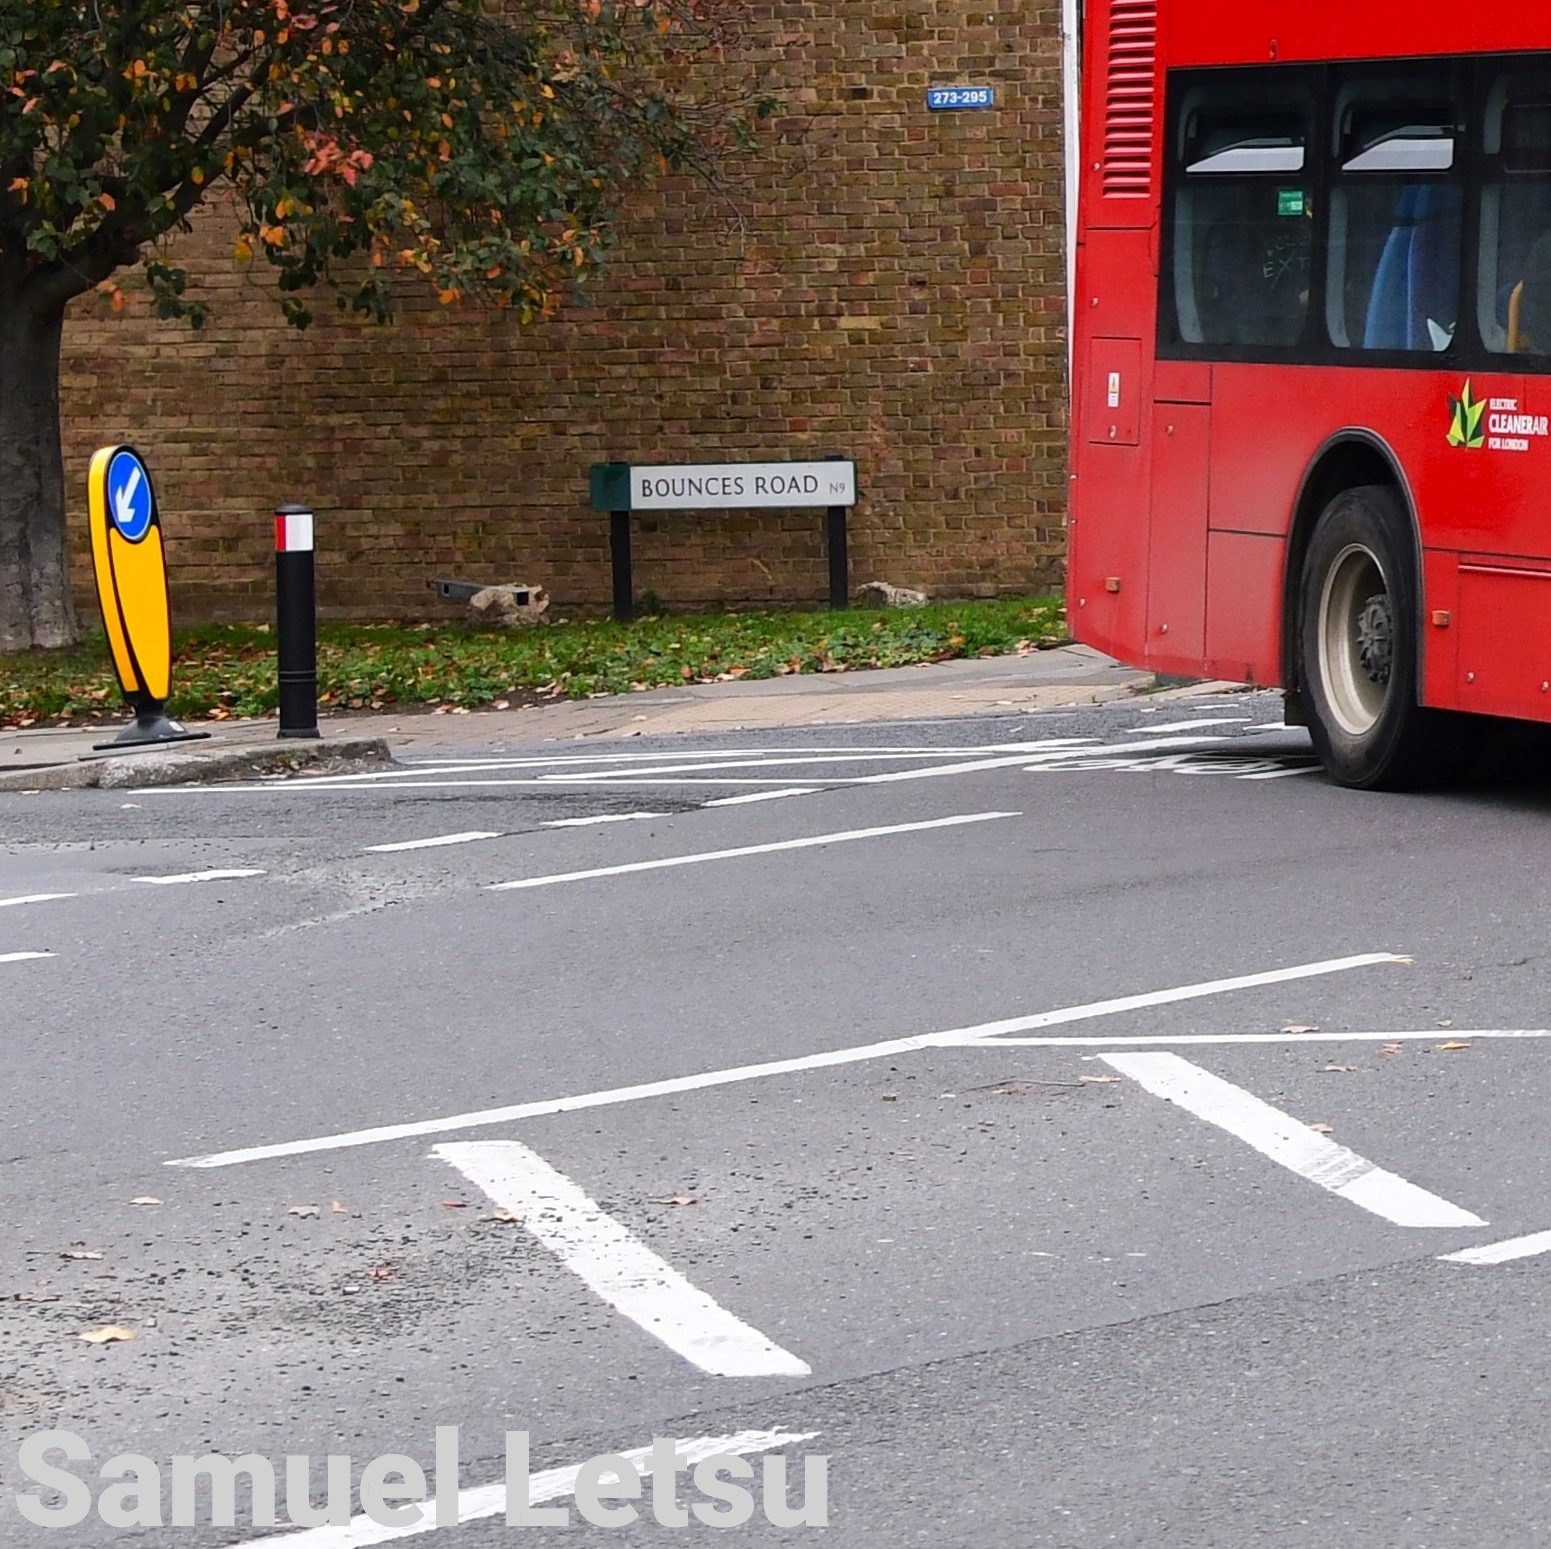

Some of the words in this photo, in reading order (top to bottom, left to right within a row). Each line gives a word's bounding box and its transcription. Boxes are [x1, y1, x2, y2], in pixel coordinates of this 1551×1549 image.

[933, 90, 987, 104] 273-295
[1489, 397, 1518, 411] ELECTRIC
[641, 476, 744, 498] BOUNCES
[755, 474, 819, 495] ROAD
[829, 482, 846, 495] N9
